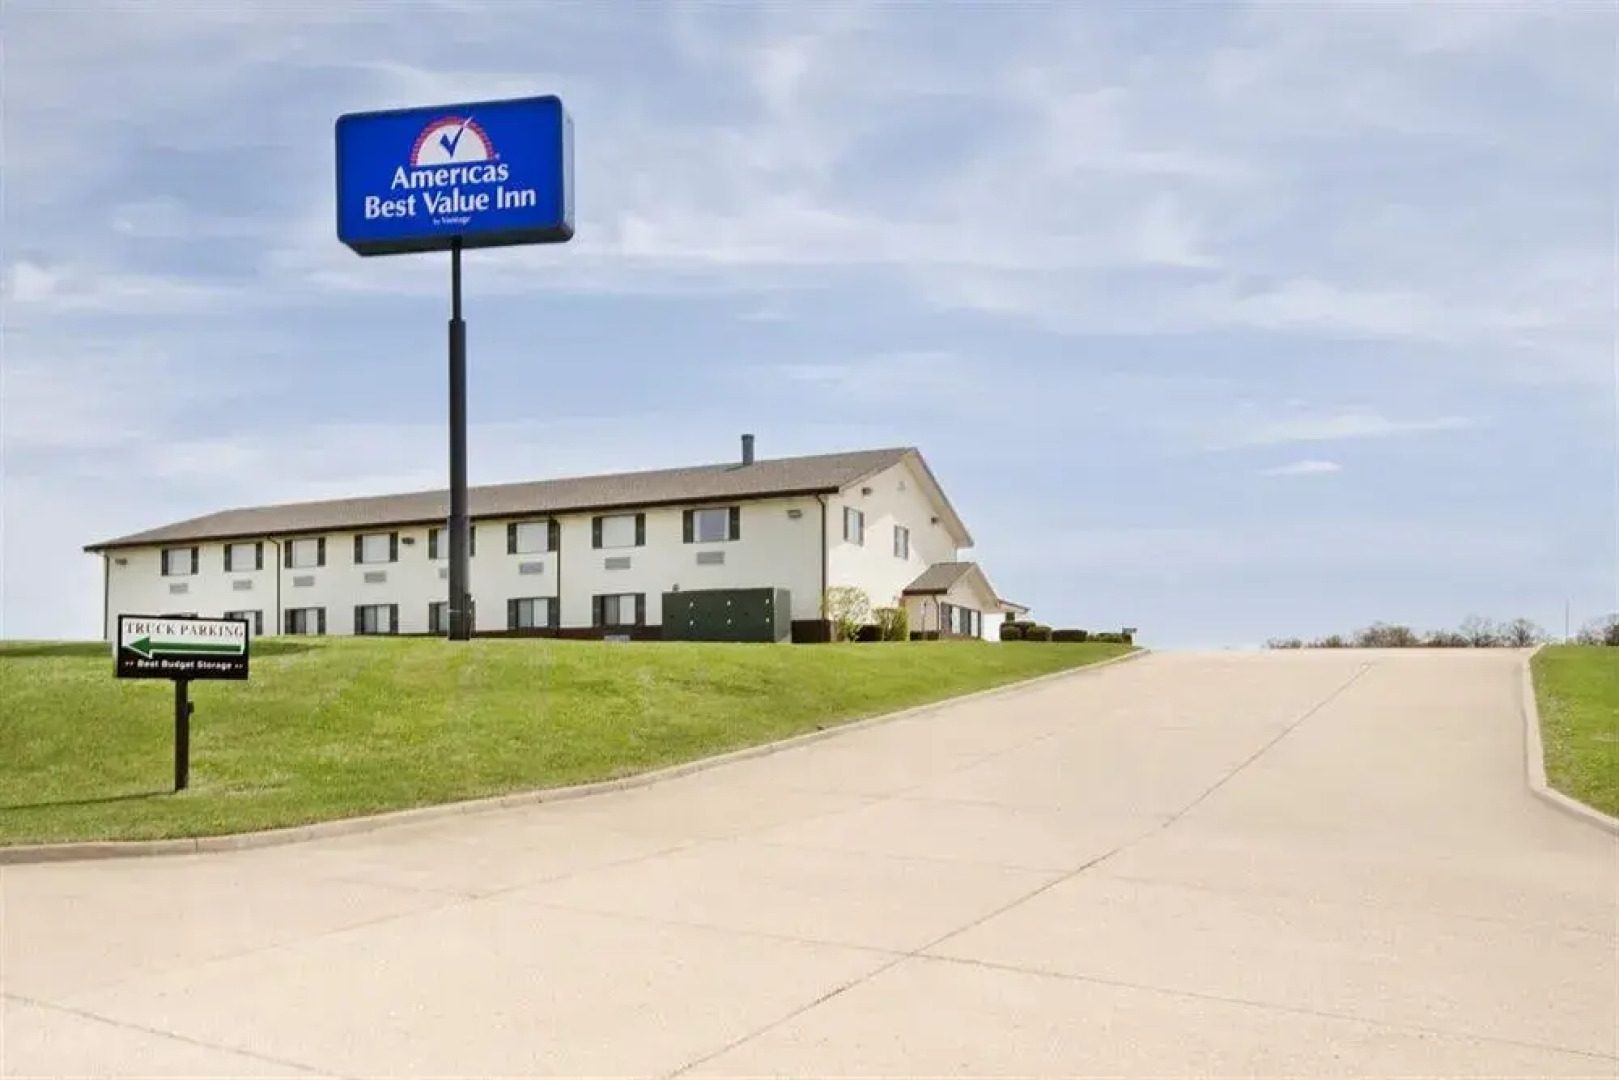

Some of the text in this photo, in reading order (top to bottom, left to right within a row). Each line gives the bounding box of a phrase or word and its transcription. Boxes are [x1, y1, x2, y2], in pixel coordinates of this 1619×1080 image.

[391, 163, 509, 190] Americas
[364, 185, 537, 219] Best Value Inn
[126, 621, 244, 636] TRUCK PARKING
[161, 660, 195, 670] Budget
[197, 661, 232, 671] Storage
